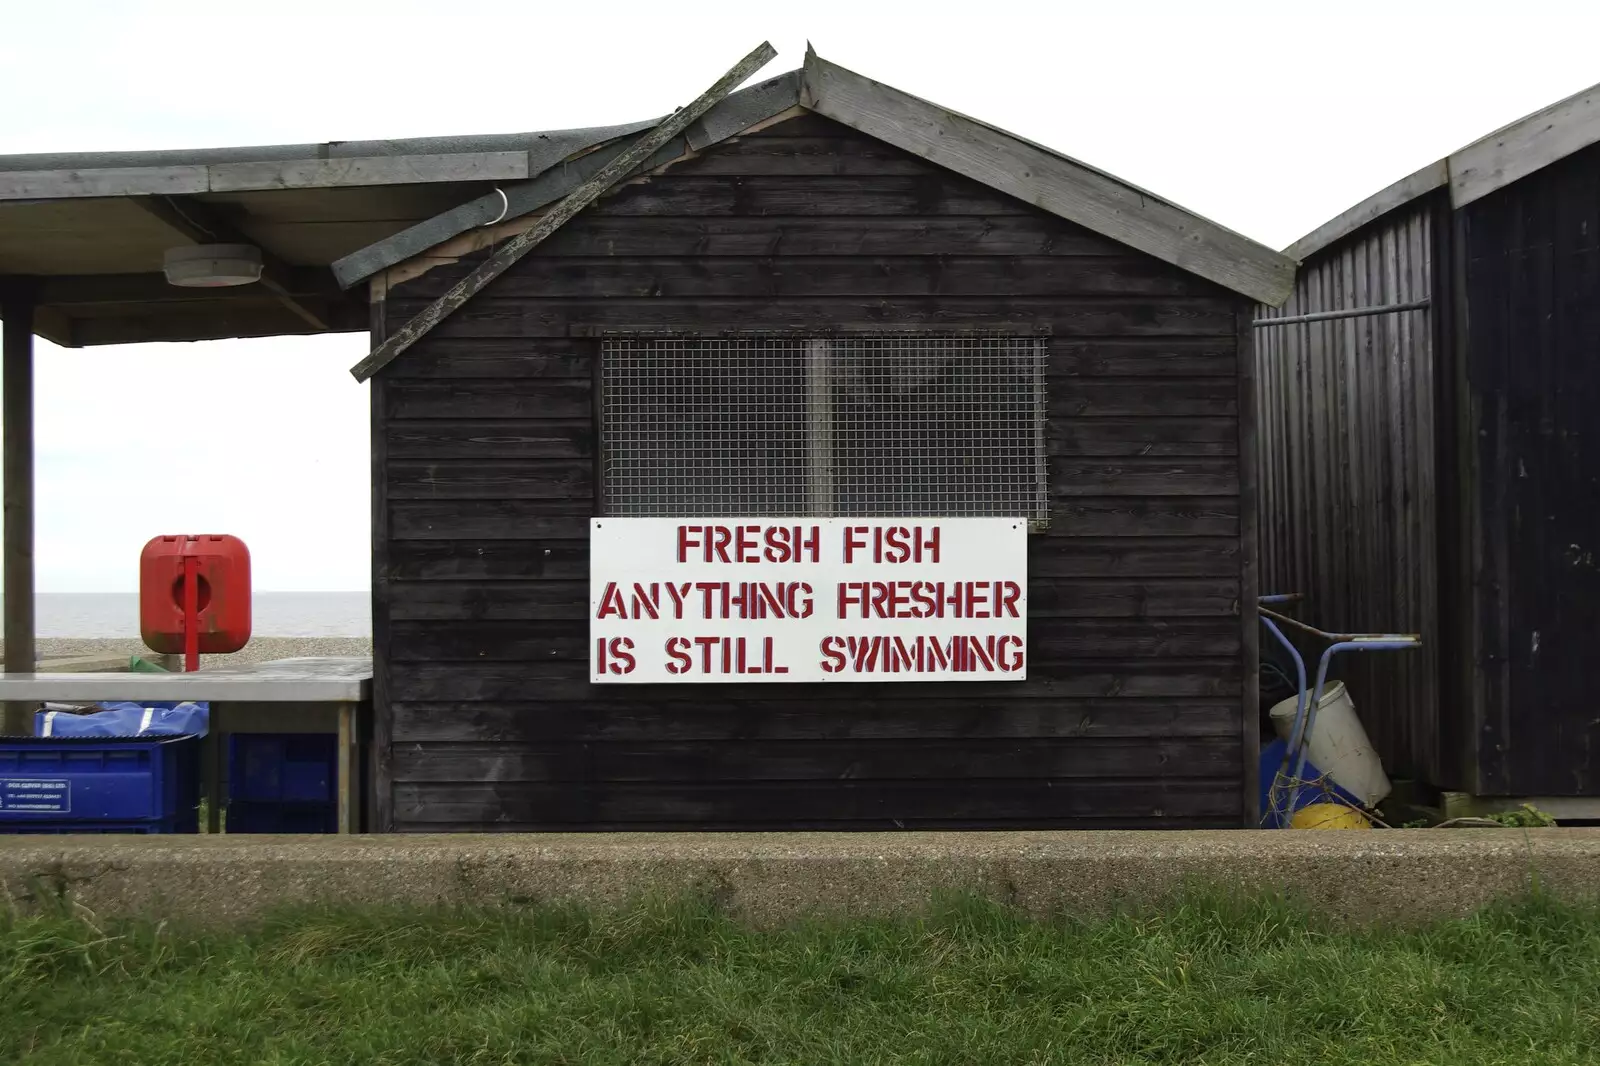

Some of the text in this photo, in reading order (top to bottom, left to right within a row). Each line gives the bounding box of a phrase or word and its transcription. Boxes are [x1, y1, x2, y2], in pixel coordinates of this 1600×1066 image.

[677, 525, 940, 563] FRESH FISH
[597, 581, 1020, 619] ANYTHING FRESHER
[597, 635, 1024, 674] IS STILL SWIMMING
